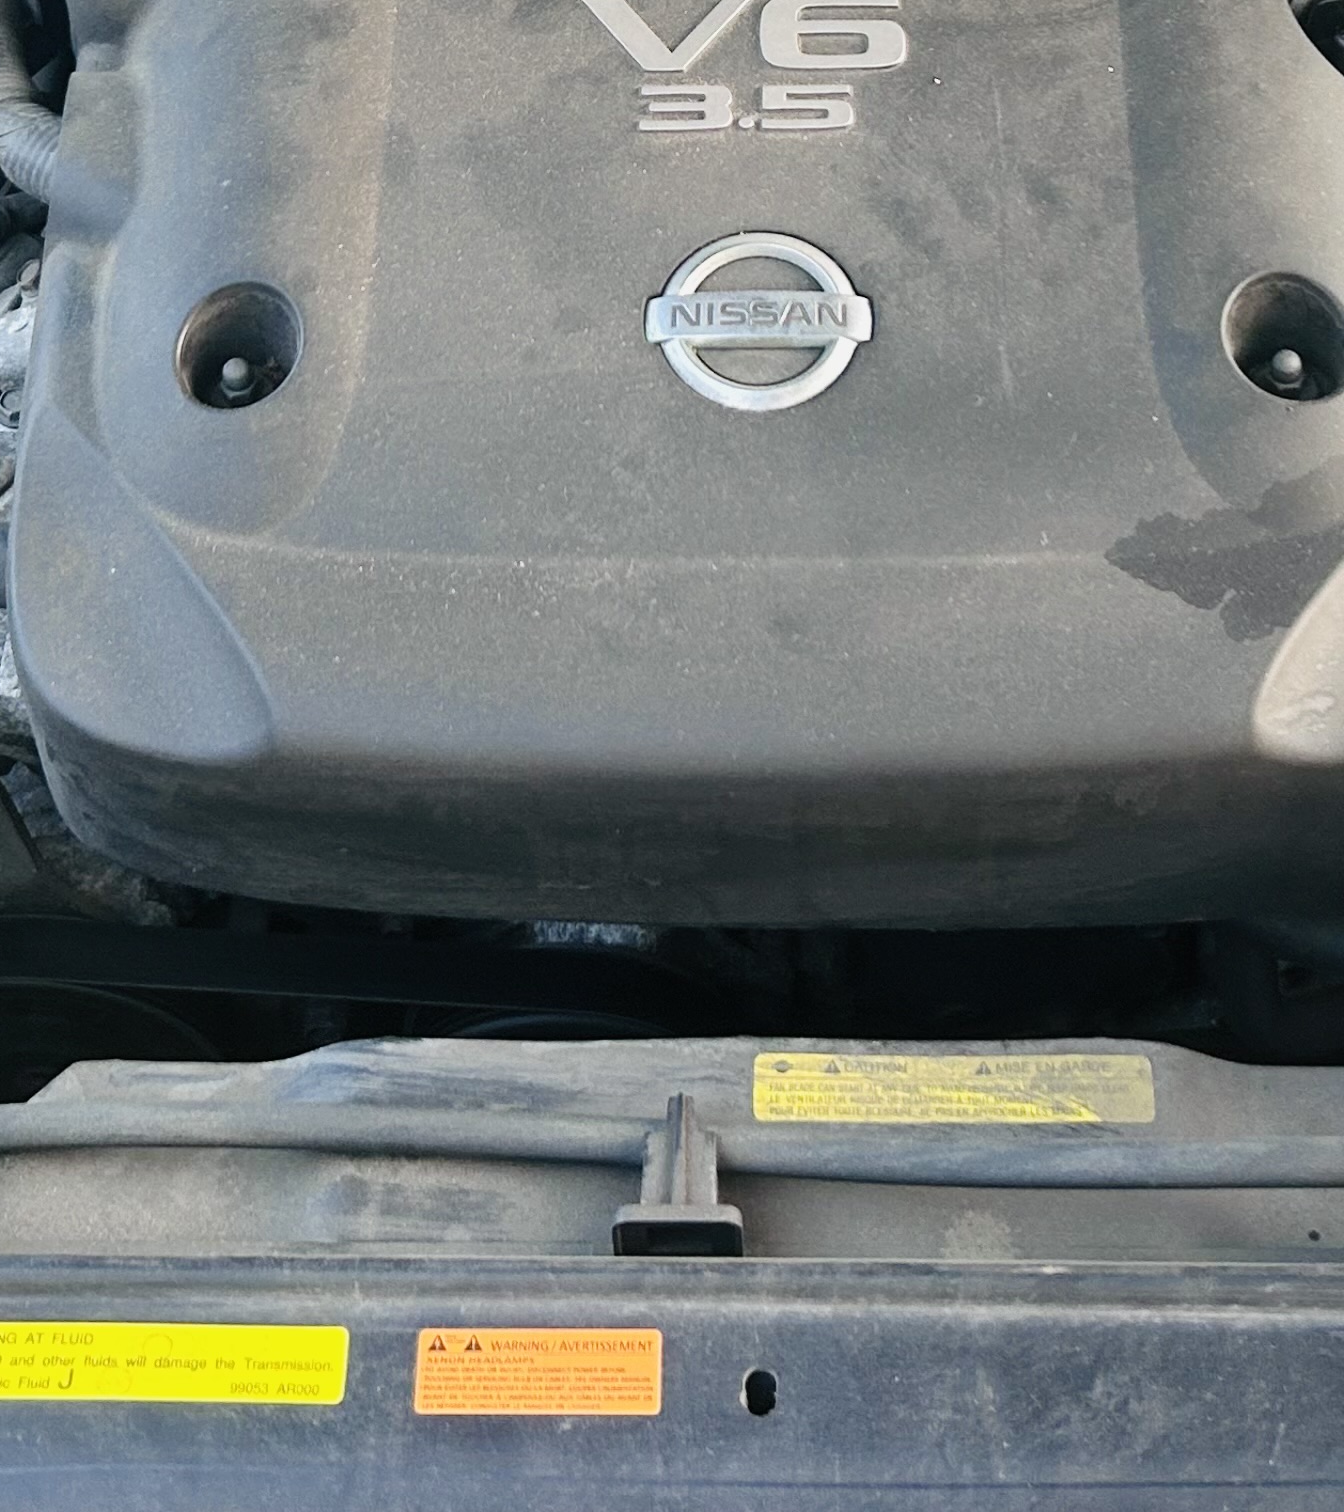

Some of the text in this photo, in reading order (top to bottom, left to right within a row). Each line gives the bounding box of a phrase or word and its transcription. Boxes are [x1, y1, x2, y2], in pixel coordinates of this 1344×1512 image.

[638, 84, 854, 131] 3.5
[670, 301, 848, 329] NISSAN
[25, 1332, 45, 1345] AT
[52, 1332, 94, 1346] FLUID
[491, 1339, 549, 1352] WARNING
[559, 1339, 653, 1353] AVERTISSEMENT
[9, 1354, 35, 1367] and
[42, 1355, 76, 1367] other
[126, 1355, 147, 1368] will
[154, 1356, 207, 1372] damage
[215, 1356, 236, 1371] the
[18, 1375, 50, 1389] Fluid
[57, 1368, 74, 1390] J
[229, 1381, 269, 1395] 99053
